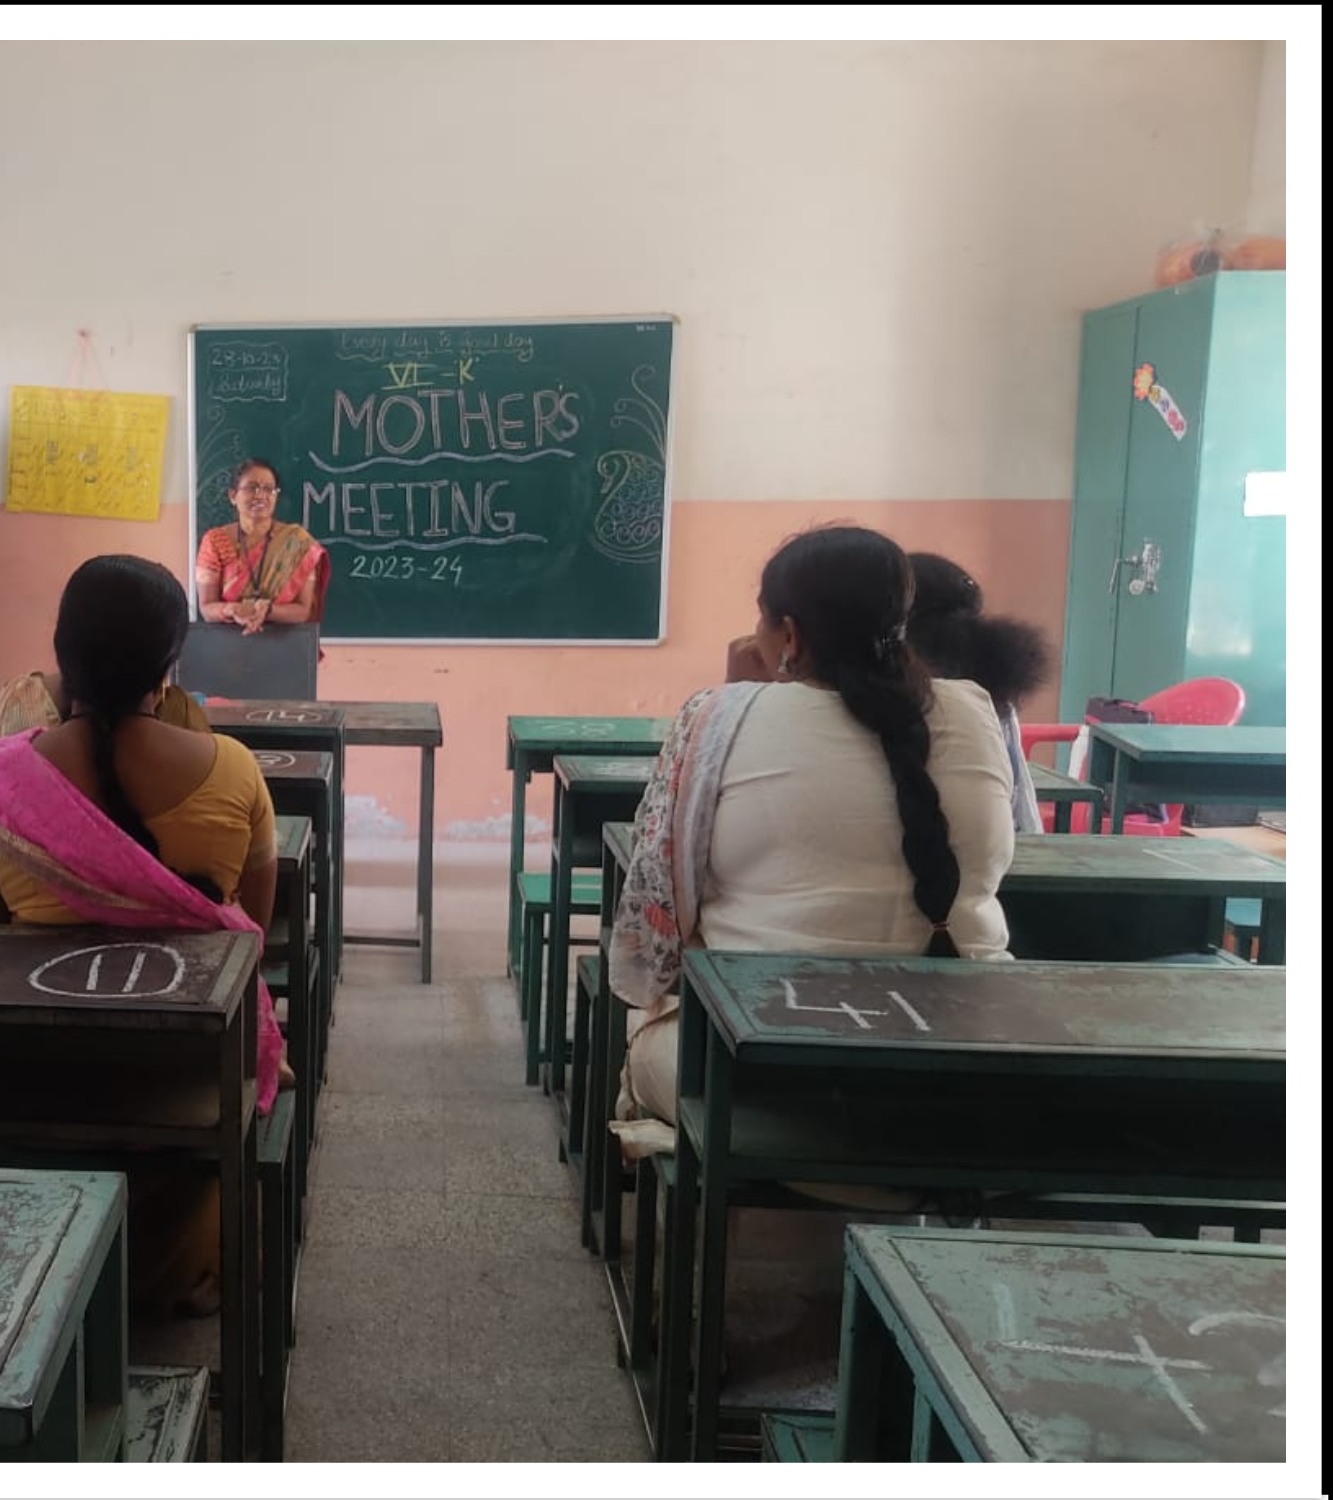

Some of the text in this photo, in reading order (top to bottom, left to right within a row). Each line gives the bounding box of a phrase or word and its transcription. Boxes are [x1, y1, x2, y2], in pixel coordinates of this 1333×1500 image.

[332, 384, 581, 456] MOTHER'S
[302, 479, 517, 537] MEETING
[349, 554, 464, 586] 2023-24
[85, 952, 147, 993] 11
